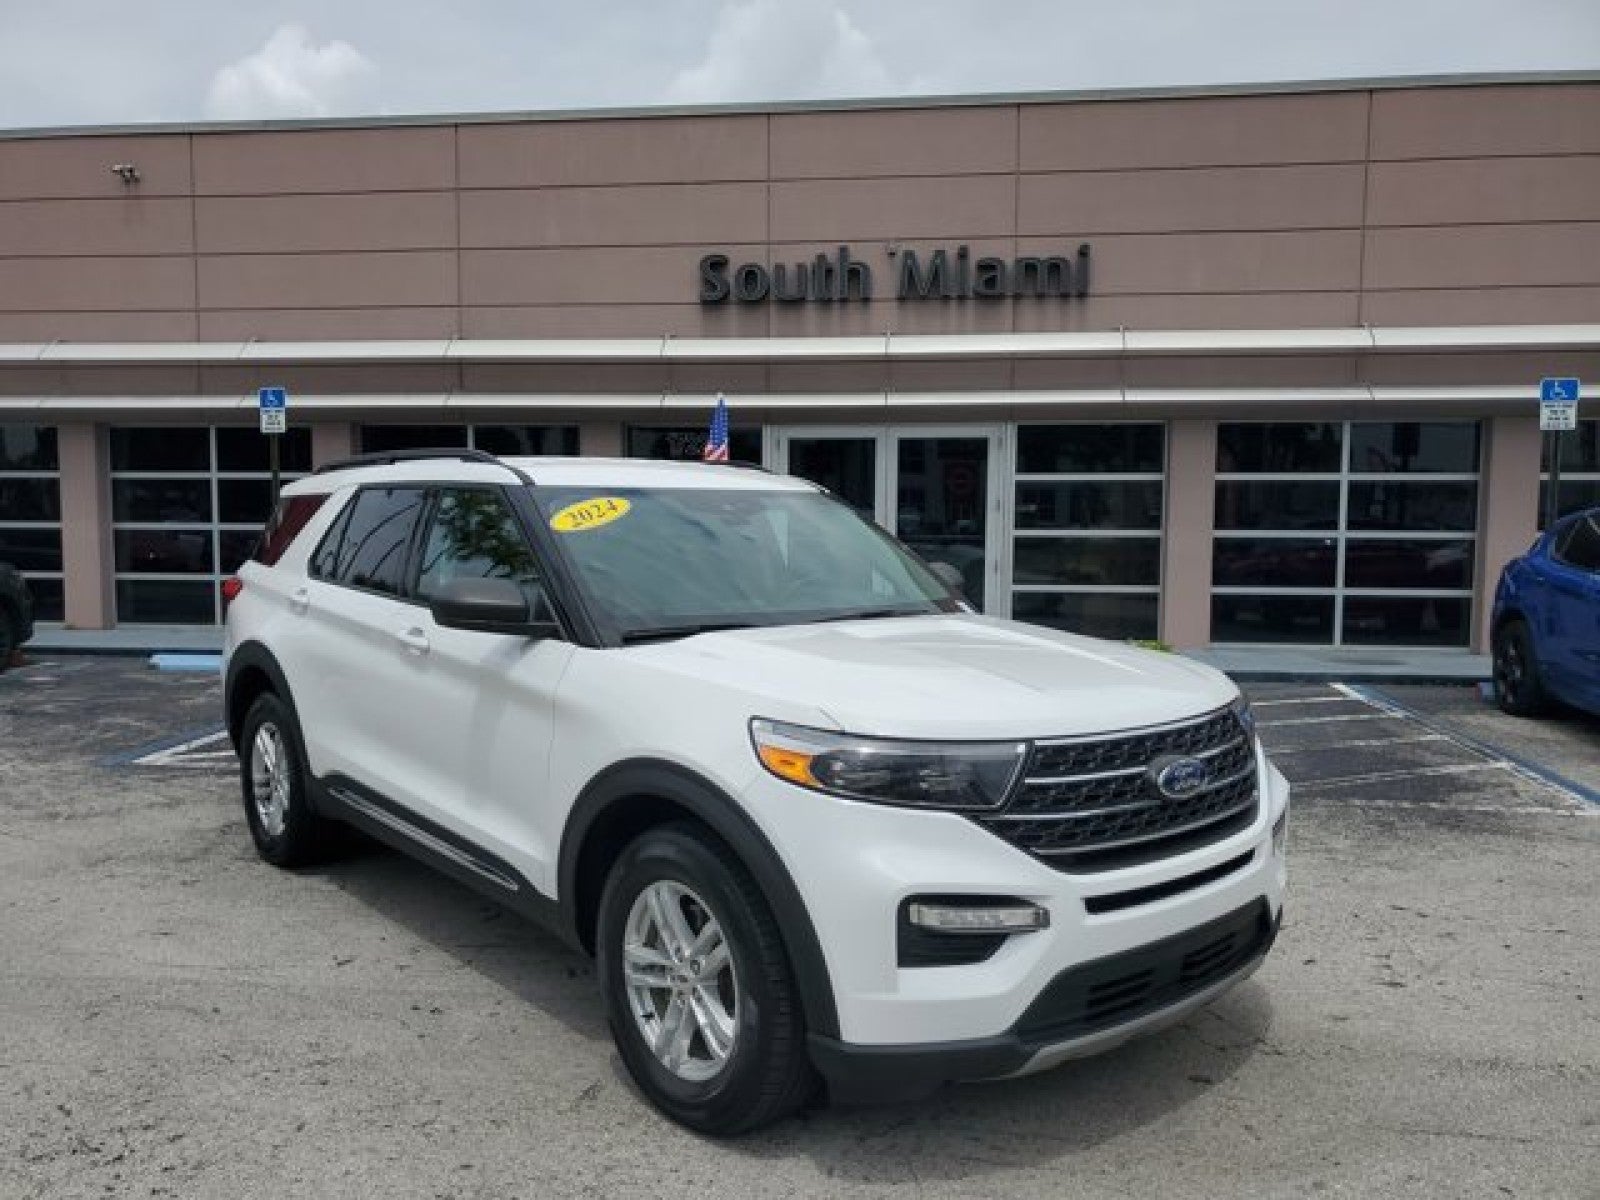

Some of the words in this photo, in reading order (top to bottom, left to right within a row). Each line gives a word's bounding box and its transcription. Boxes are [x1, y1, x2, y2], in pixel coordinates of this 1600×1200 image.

[700, 245, 871, 302] South
[897, 244, 1091, 301] Miami
[567, 499, 619, 528] 2024
